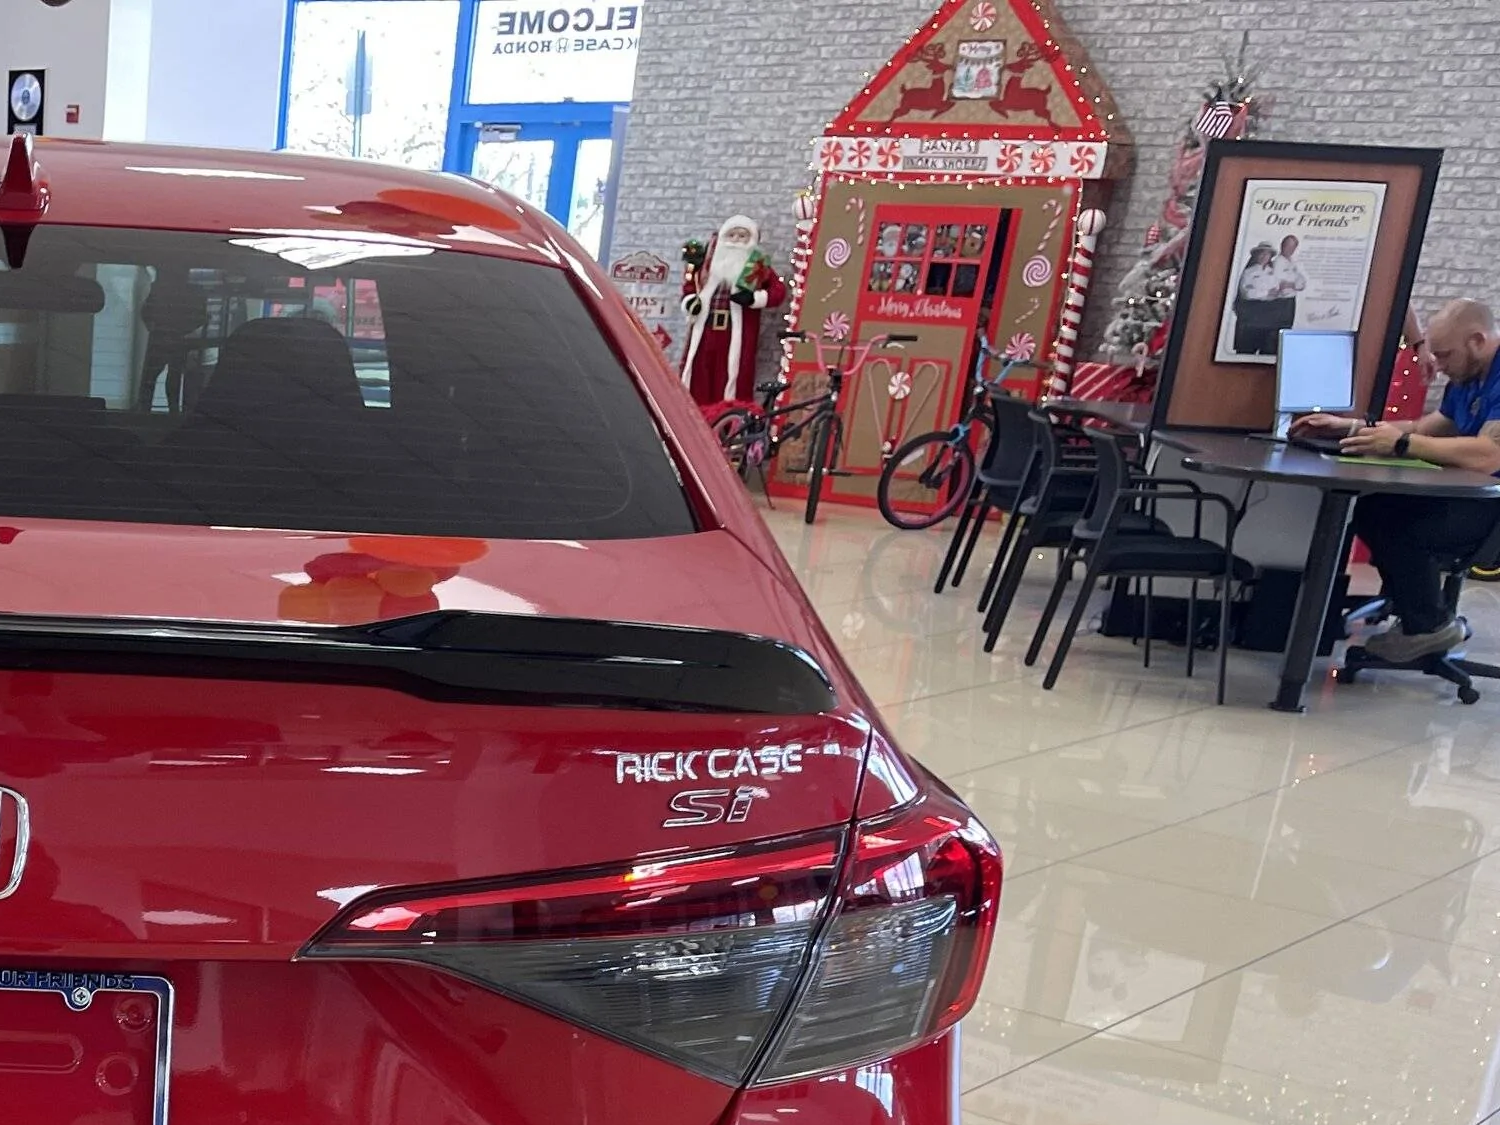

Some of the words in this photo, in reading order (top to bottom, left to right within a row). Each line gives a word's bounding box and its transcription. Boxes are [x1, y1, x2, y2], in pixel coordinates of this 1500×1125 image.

[1266, 214, 1293, 226] Our
[616, 751, 700, 784] RICK
[707, 743, 803, 779] CASE
[34, 973, 135, 990] FRIENDS
